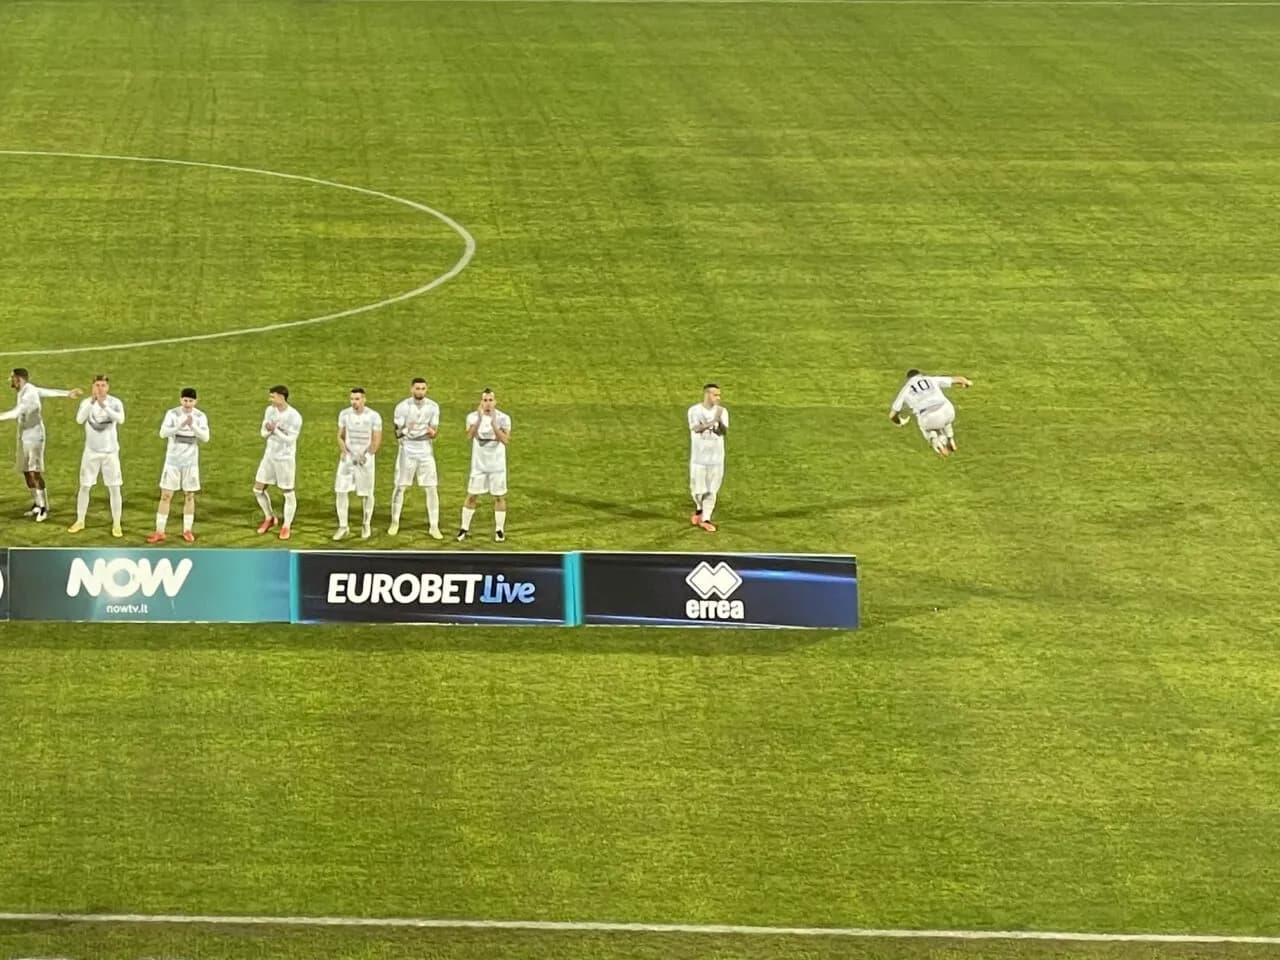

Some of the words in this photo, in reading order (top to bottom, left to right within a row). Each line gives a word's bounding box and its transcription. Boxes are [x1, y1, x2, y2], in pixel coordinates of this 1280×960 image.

[66, 557, 193, 598] NOW
[106, 602, 149, 614] nowtv.it
[685, 599, 745, 619] errea
